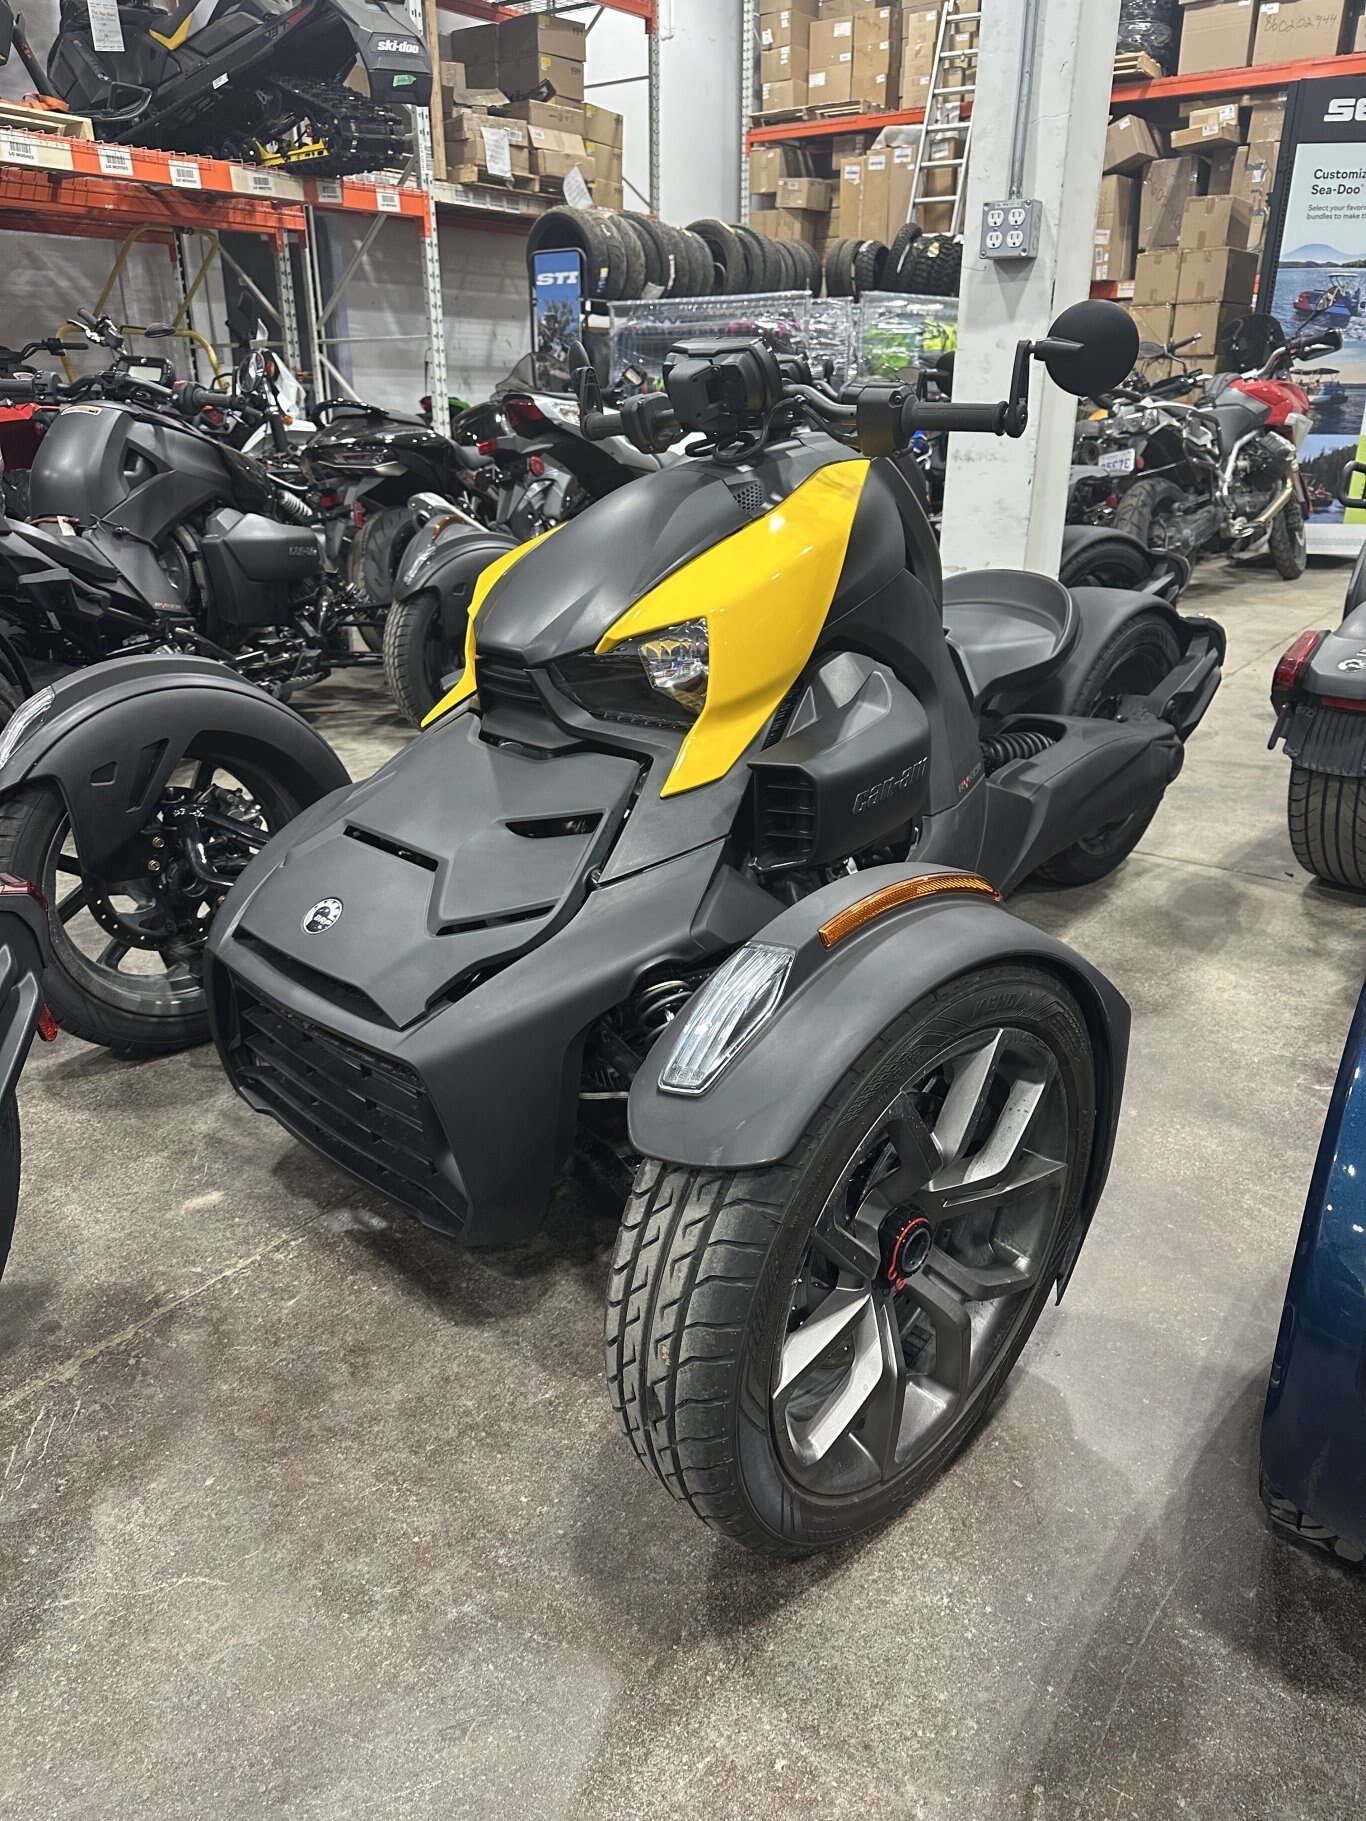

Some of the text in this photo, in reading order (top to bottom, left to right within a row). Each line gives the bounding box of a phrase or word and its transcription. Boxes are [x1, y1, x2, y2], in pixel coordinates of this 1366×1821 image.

[377, 39, 419, 54] ski-doo
[1308, 204, 1329, 212] Select
[1330, 205, 1346, 213] your
[536, 271, 579, 285] STI
[313, 914, 332, 926] BRP
